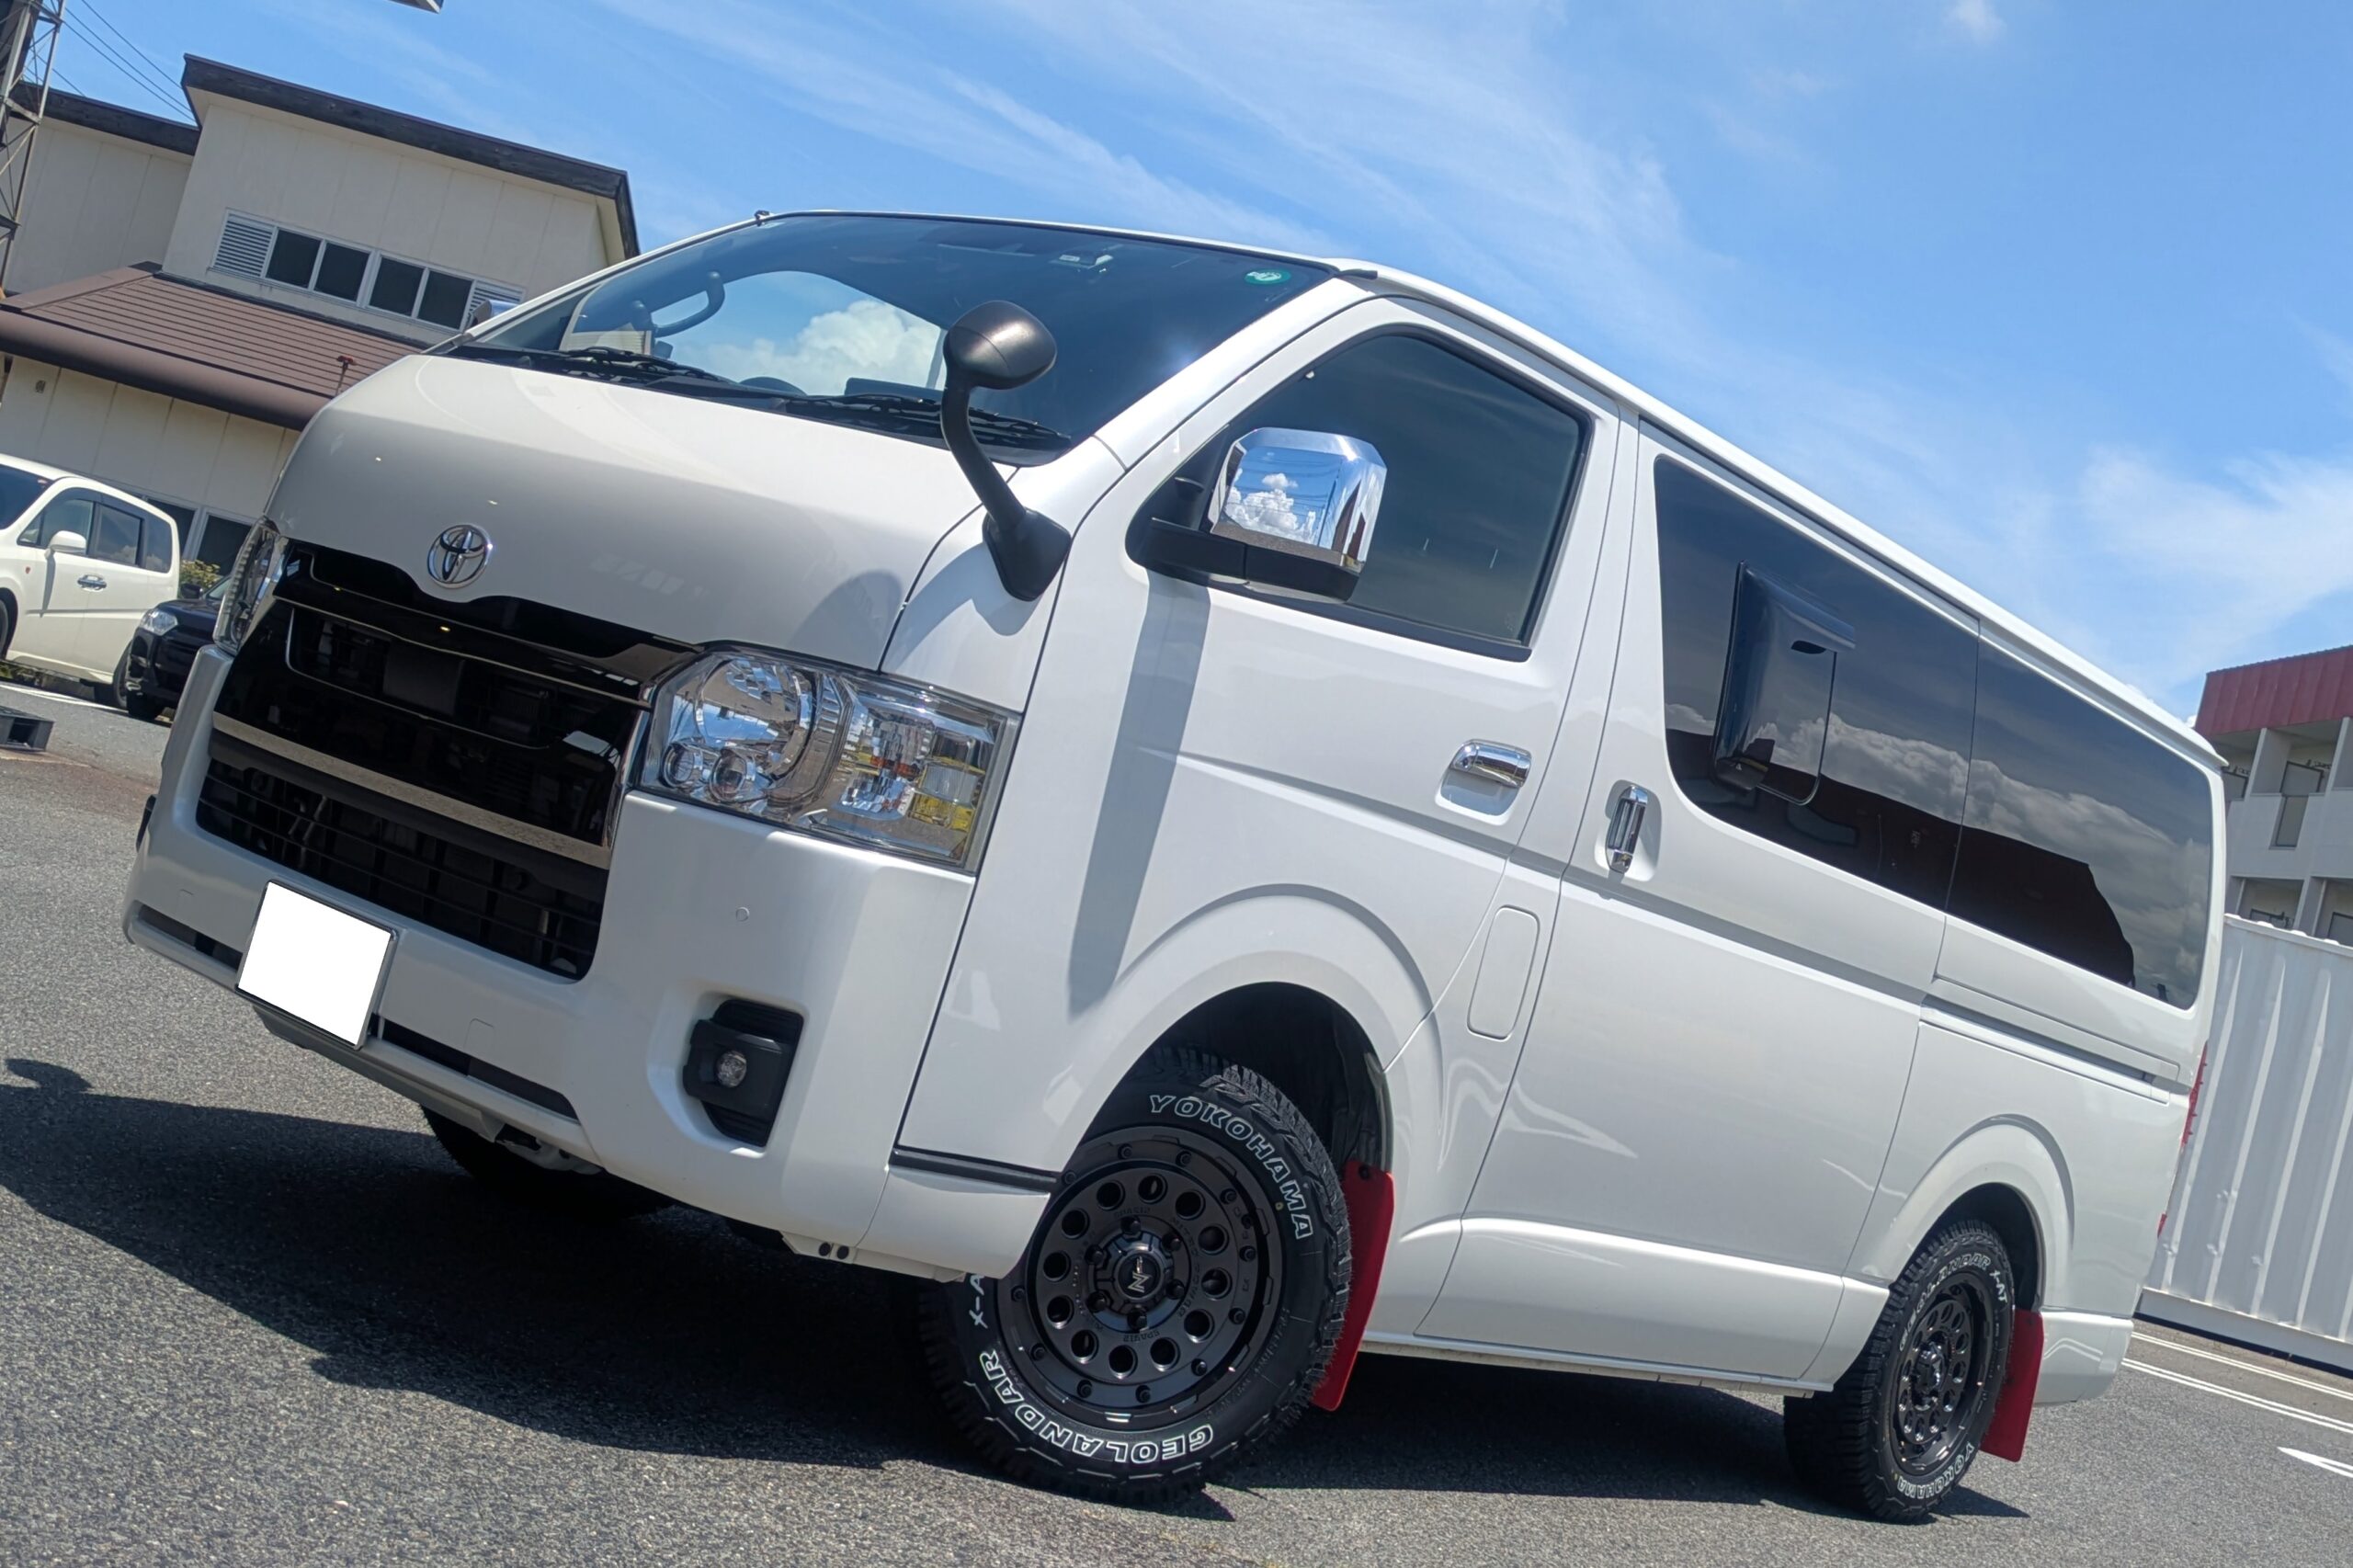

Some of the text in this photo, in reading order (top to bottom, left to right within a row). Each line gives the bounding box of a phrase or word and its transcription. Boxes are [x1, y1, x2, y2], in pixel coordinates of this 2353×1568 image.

[1149, 1094, 1314, 1240] YOKOHAMA
[968, 1273, 989, 1330] X-A
[1899, 1252, 1992, 1352] GEOLANDAR
[1989, 1269, 2008, 1303] X-AT
[978, 1347, 1214, 1463] GEOLANDAR
[1896, 1440, 1975, 1500] YOKOHAMA
